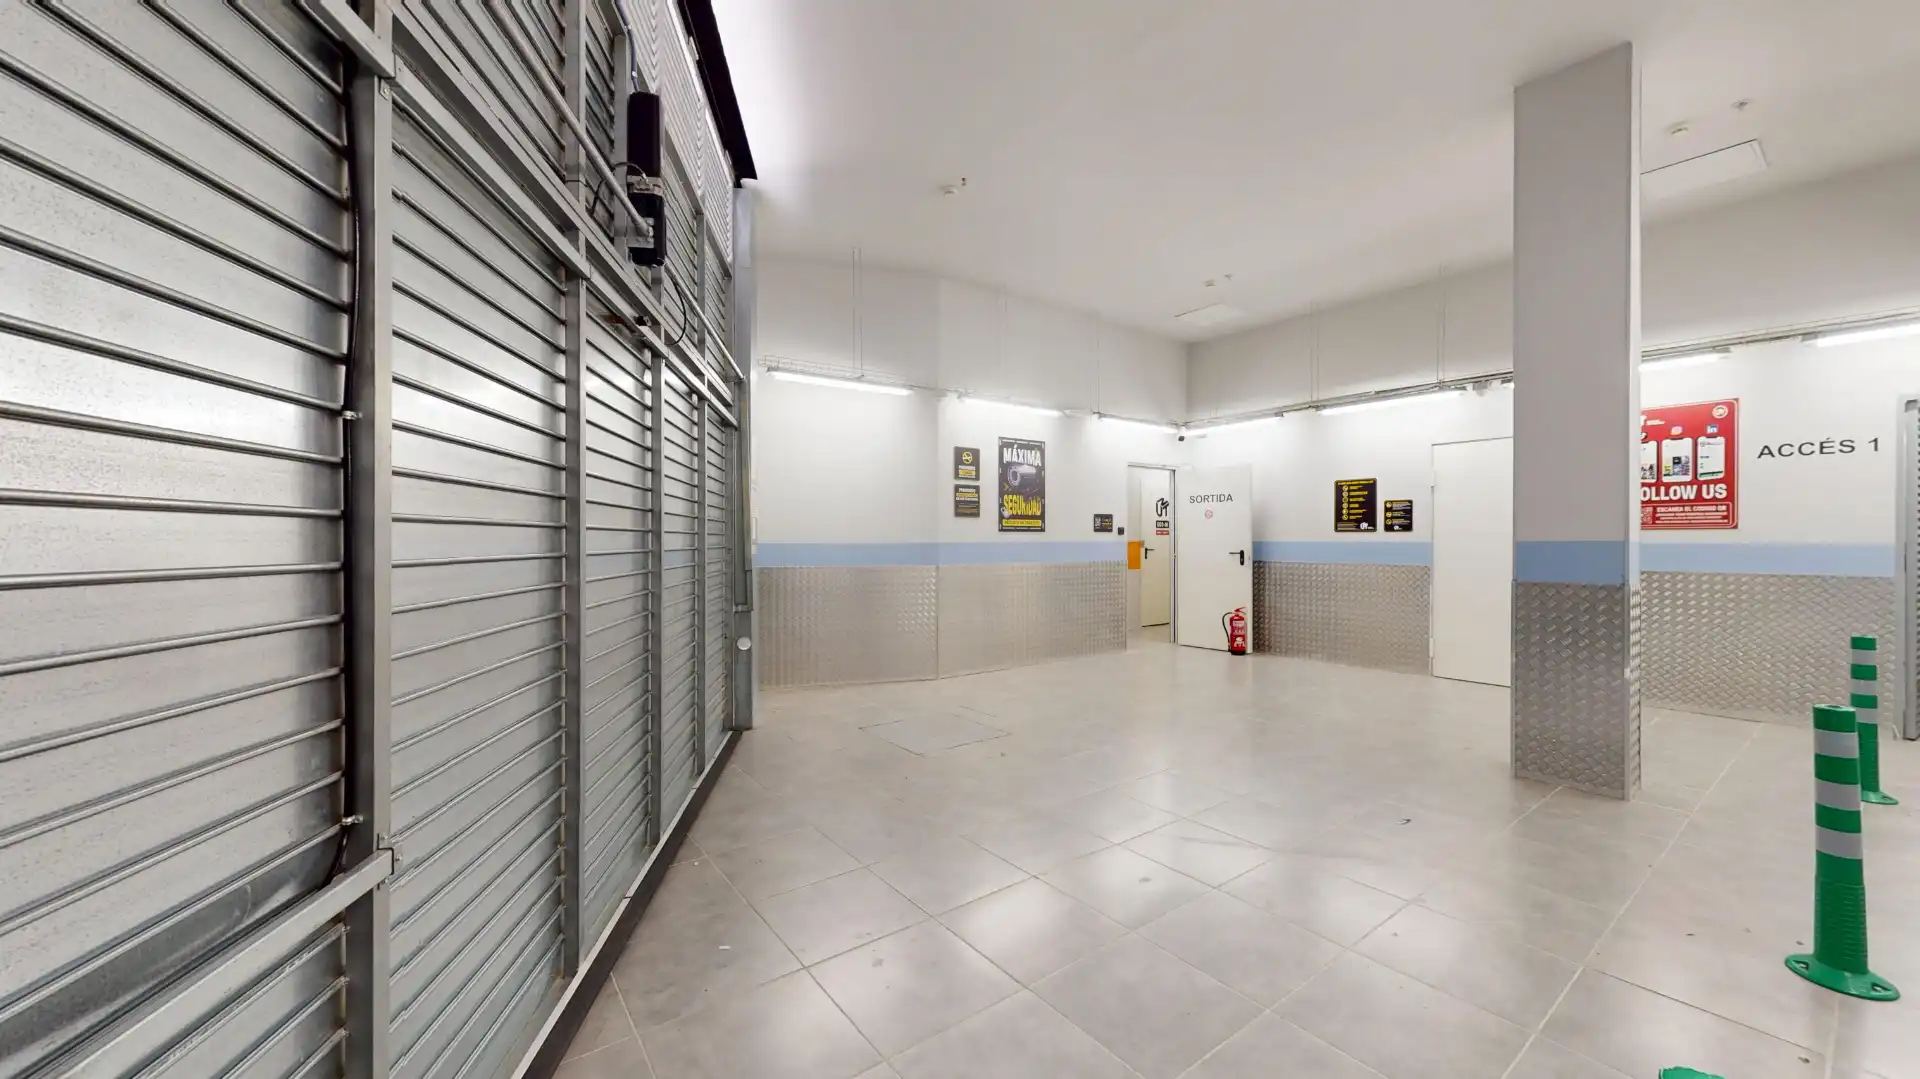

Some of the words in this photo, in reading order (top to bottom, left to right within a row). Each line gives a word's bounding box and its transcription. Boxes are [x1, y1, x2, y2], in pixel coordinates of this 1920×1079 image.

[1003, 444, 1042, 466] MÁXIMA
[1757, 437, 1856, 458] ACCÉS
[1868, 437, 1879, 452] 1
[1189, 493, 1234, 504] SORTIDA
[1640, 485, 1697, 502] OLLOW
[1701, 483, 1728, 499] US
